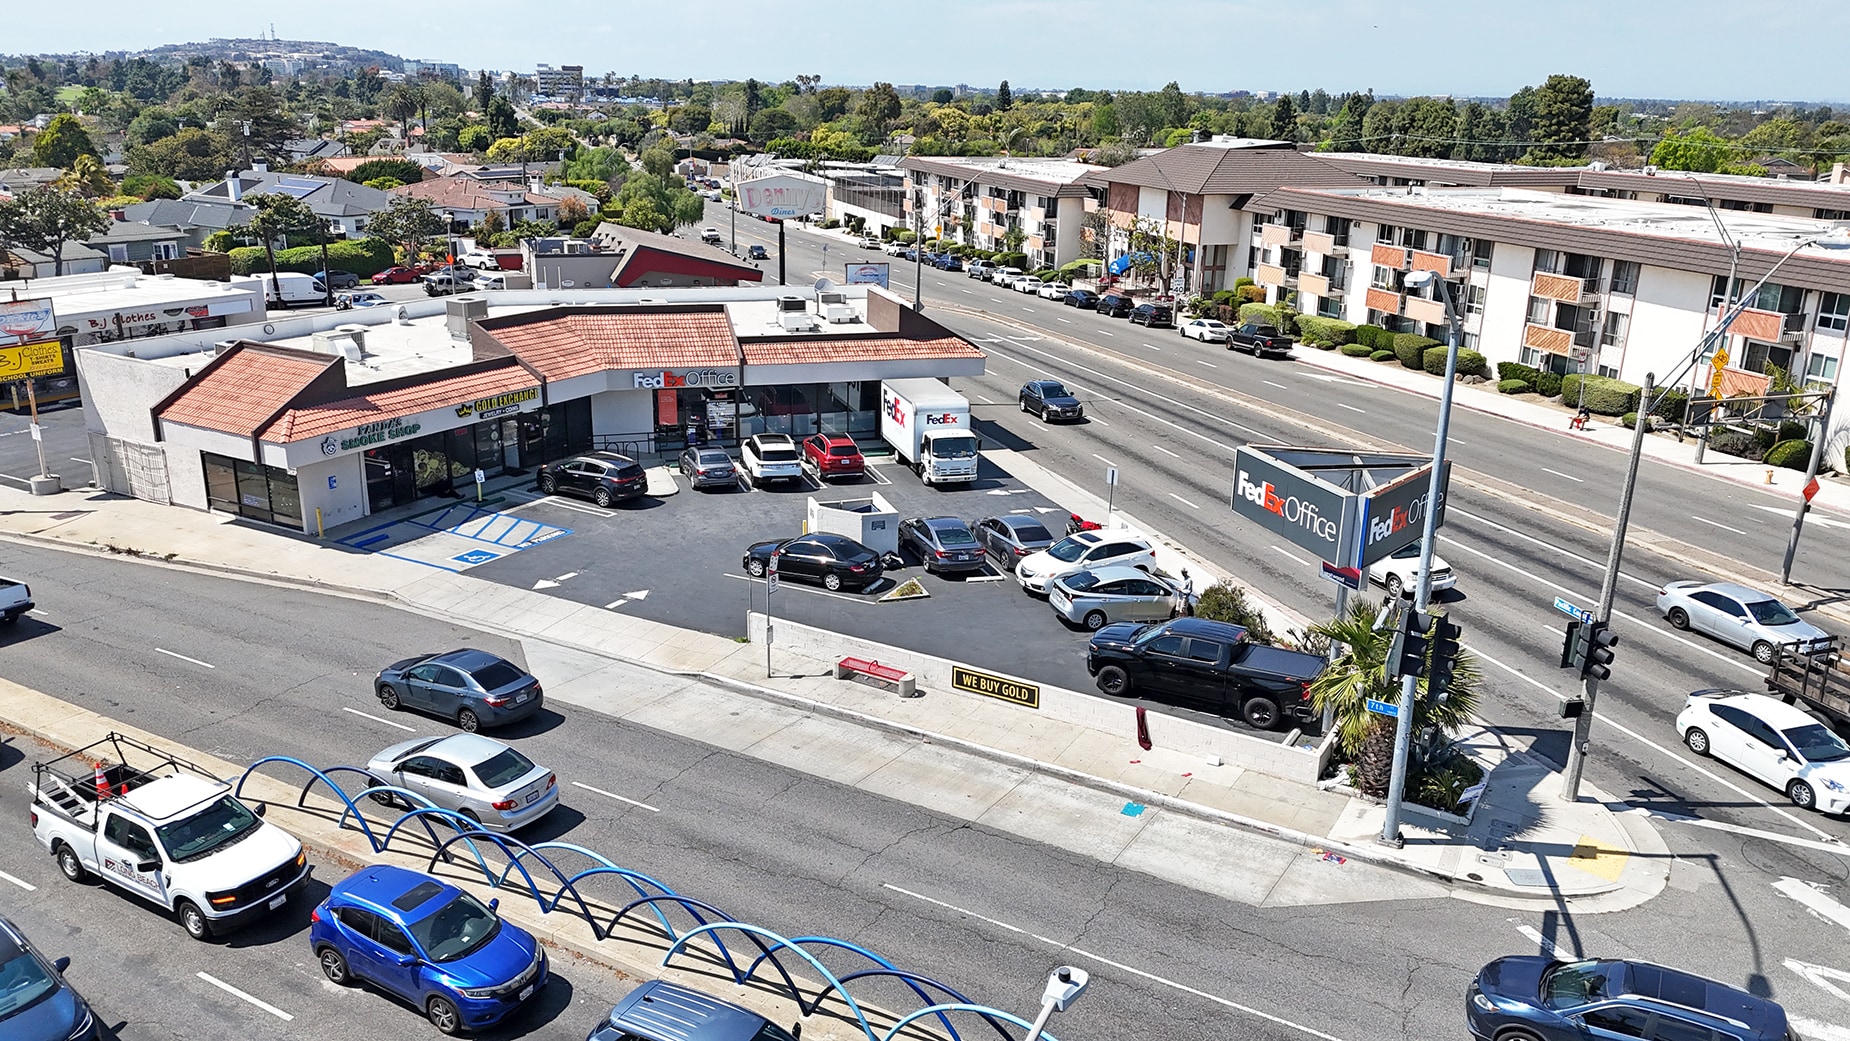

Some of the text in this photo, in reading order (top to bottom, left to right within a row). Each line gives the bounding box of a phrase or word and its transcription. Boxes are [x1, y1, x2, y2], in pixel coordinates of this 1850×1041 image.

[771, 207, 796, 215] Diner
[22, 345, 58, 357] Clothes
[30, 368, 64, 377] UNIFORM
[633, 370, 735, 388] FedEx Office
[475, 388, 539, 412] GOLD EXCHANGE
[482, 409, 502, 418] JEWELRY
[506, 405, 519, 413] COINS
[883, 389, 905, 429] FedEx
[926, 413, 958, 425] FedEx
[341, 424, 421, 450] SMOKE SHOP
[1237, 470, 1336, 542] FedEx Office
[1368, 491, 1444, 546] FedEx Offe
[962, 674, 1028, 700] WE BUY GOLD
[1370, 702, 1384, 711] 7th
[137, 873, 161, 889] BEACH
